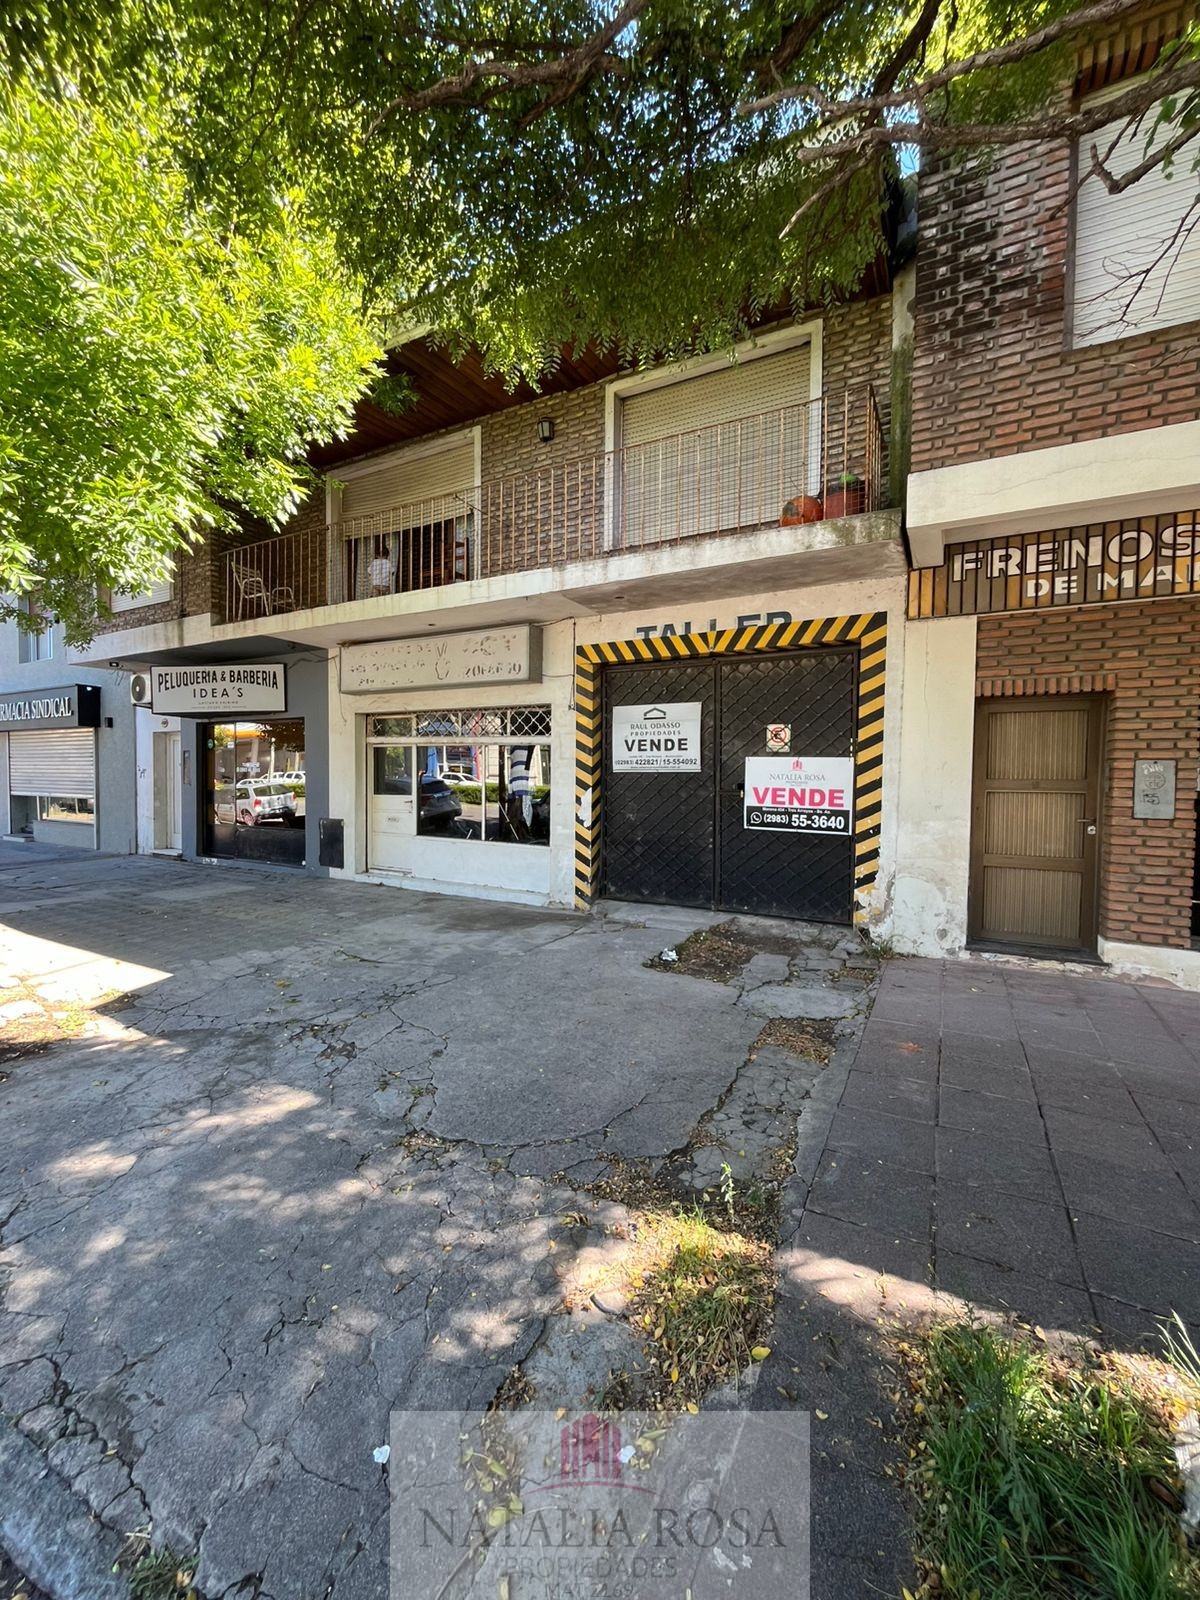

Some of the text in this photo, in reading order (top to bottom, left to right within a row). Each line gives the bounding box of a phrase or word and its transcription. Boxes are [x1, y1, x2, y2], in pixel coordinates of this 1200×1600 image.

[952, 523, 1200, 582] FRENOS
[1026, 575, 1078, 597] DE
[219, 671, 227, 682] &
[229, 670, 279, 690] BARBERIA
[31, 697, 72, 719] SINDICAL
[650, 722, 681, 730] ODASSO
[624, 738, 689, 752] VENDE
[769, 773, 826, 782] NATALIA ROSA
[752, 787, 845, 808] VENDE
[763, 813, 845, 829] (2983) 55-3640
